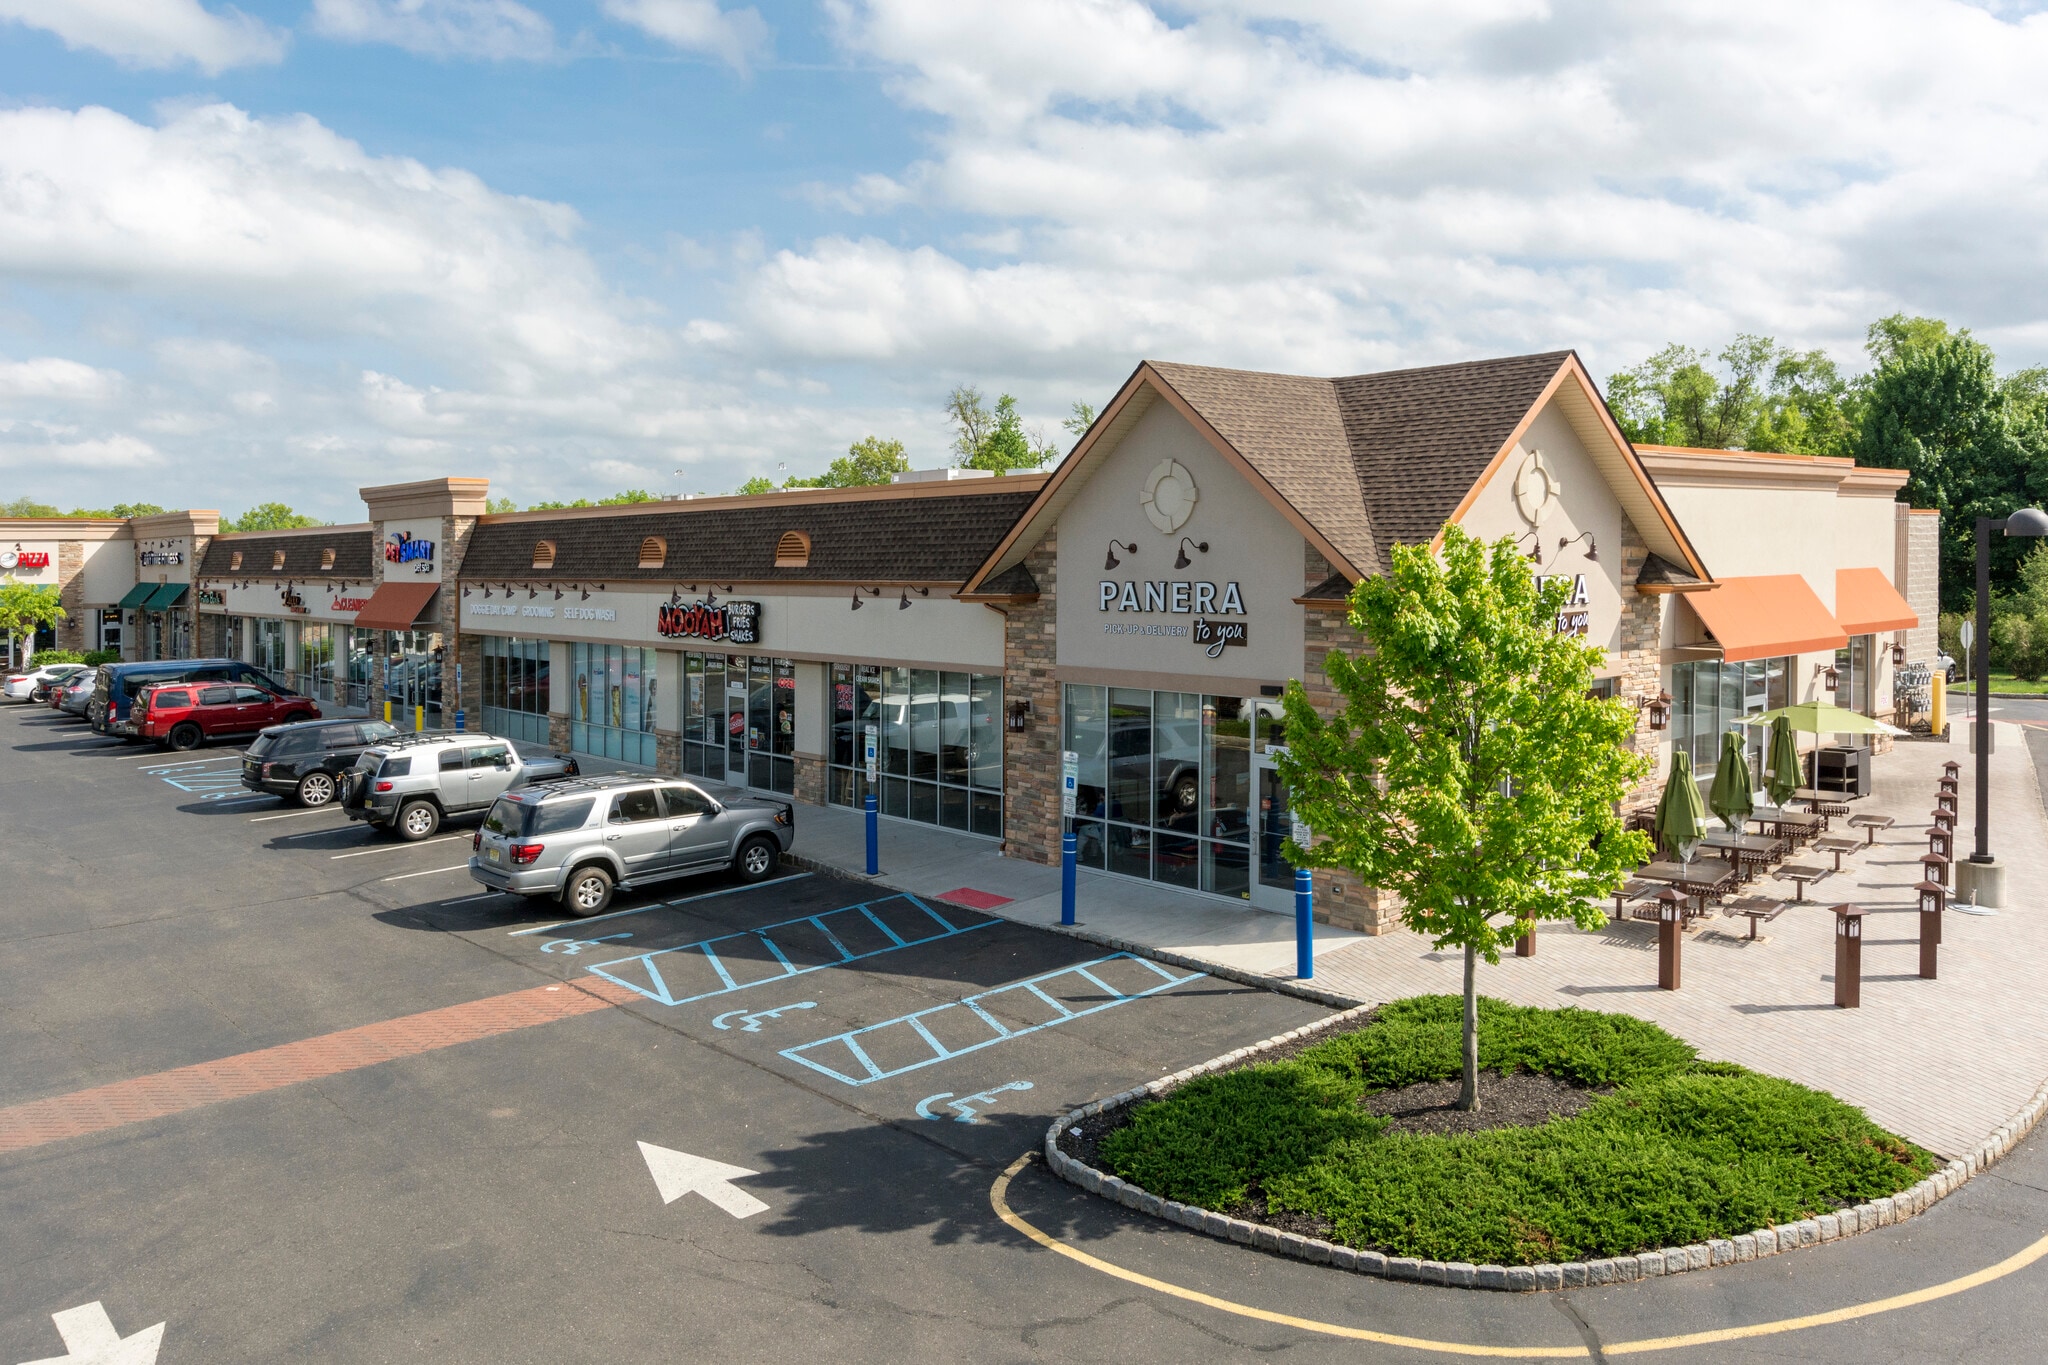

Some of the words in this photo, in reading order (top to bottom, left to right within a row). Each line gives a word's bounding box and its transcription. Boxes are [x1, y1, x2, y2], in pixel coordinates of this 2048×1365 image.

[18, 552, 49, 567] PIZZA
[1099, 581, 1247, 614] PANERA
[470, 604, 489, 615] DOGGIE
[490, 605, 500, 616] DAY
[501, 605, 517, 616] CAMP
[522, 606, 555, 618] GROOMING
[564, 607, 580, 619] SELF
[580, 608, 595, 620] DOG
[595, 609, 616, 621] WASH
[728, 603, 755, 615] BURGERS
[658, 603, 725, 639] MOOYAH
[732, 616, 750, 628] FRIES
[1556, 611, 1568, 633] to
[730, 629, 753, 642] SHAKES
[1104, 624, 1139, 634] PICK-UP
[1146, 625, 1189, 637] DELIVERY
[1196, 617, 1211, 641] to
